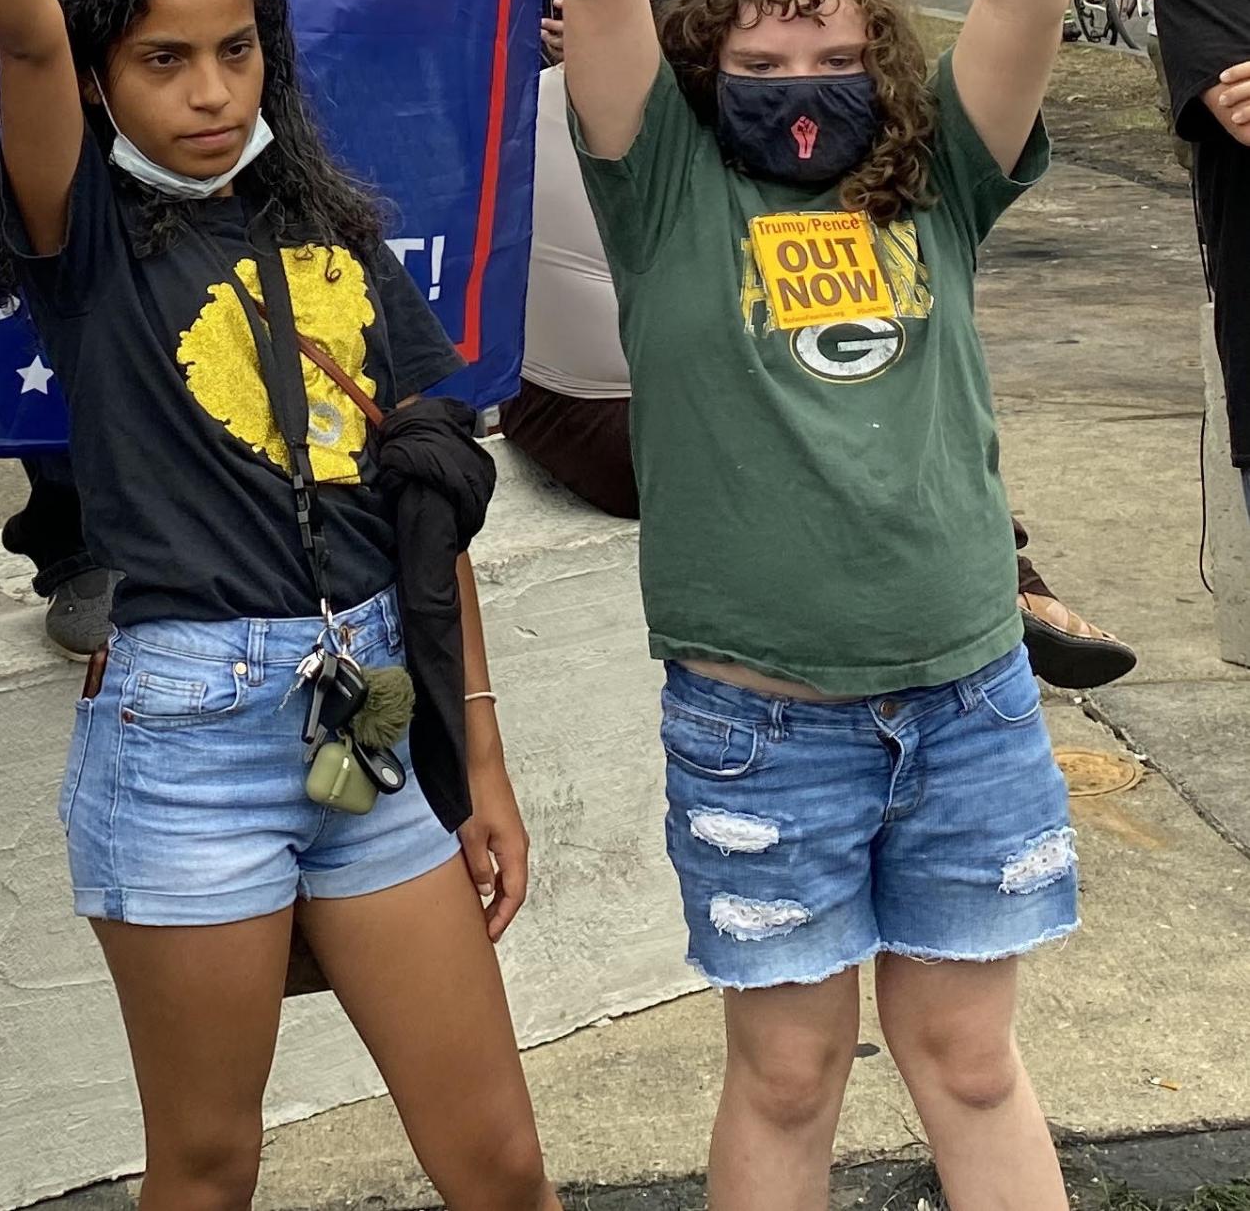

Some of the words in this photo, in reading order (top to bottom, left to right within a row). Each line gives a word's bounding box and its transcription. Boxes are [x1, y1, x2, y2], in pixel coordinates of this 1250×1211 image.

[756, 216, 861, 236] Trump/Pence
[777, 237, 858, 273] OUT
[776, 270, 878, 311] NOW
